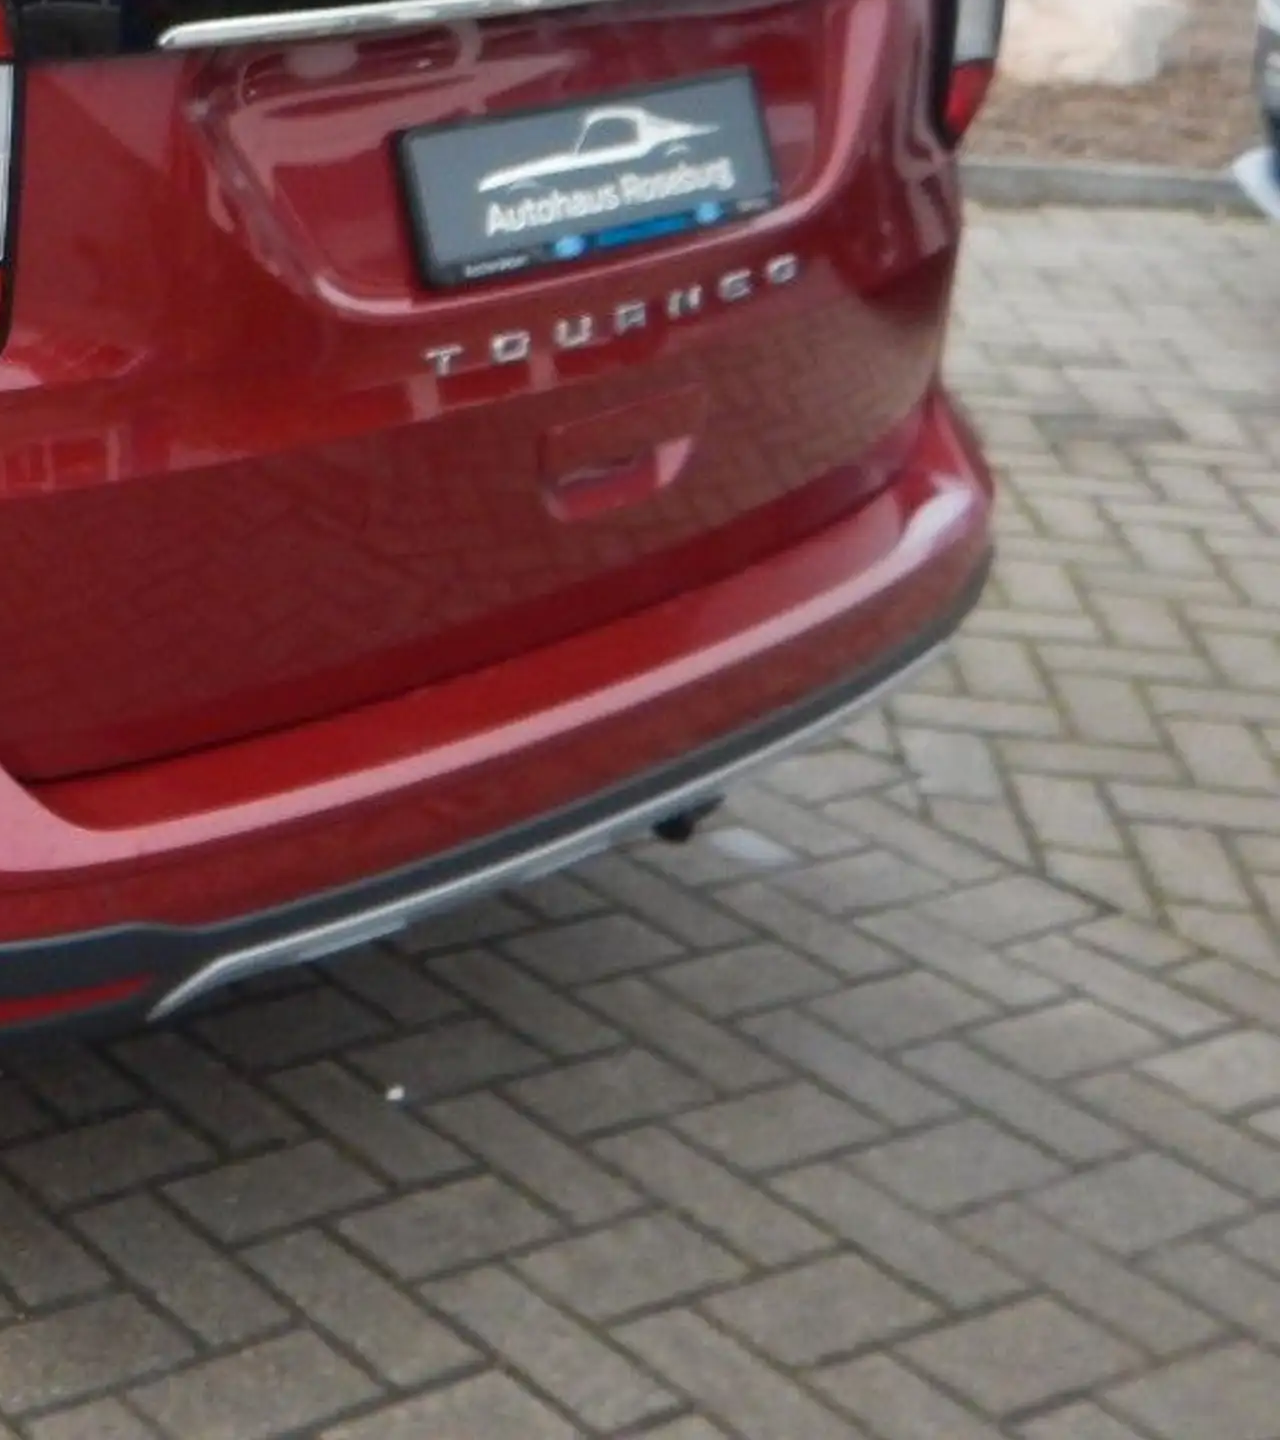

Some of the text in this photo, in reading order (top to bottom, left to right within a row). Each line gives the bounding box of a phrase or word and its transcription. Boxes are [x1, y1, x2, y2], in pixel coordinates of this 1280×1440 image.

[485, 156, 736, 237] Autohaus Roseburg
[424, 253, 796, 376] TOURNEO
